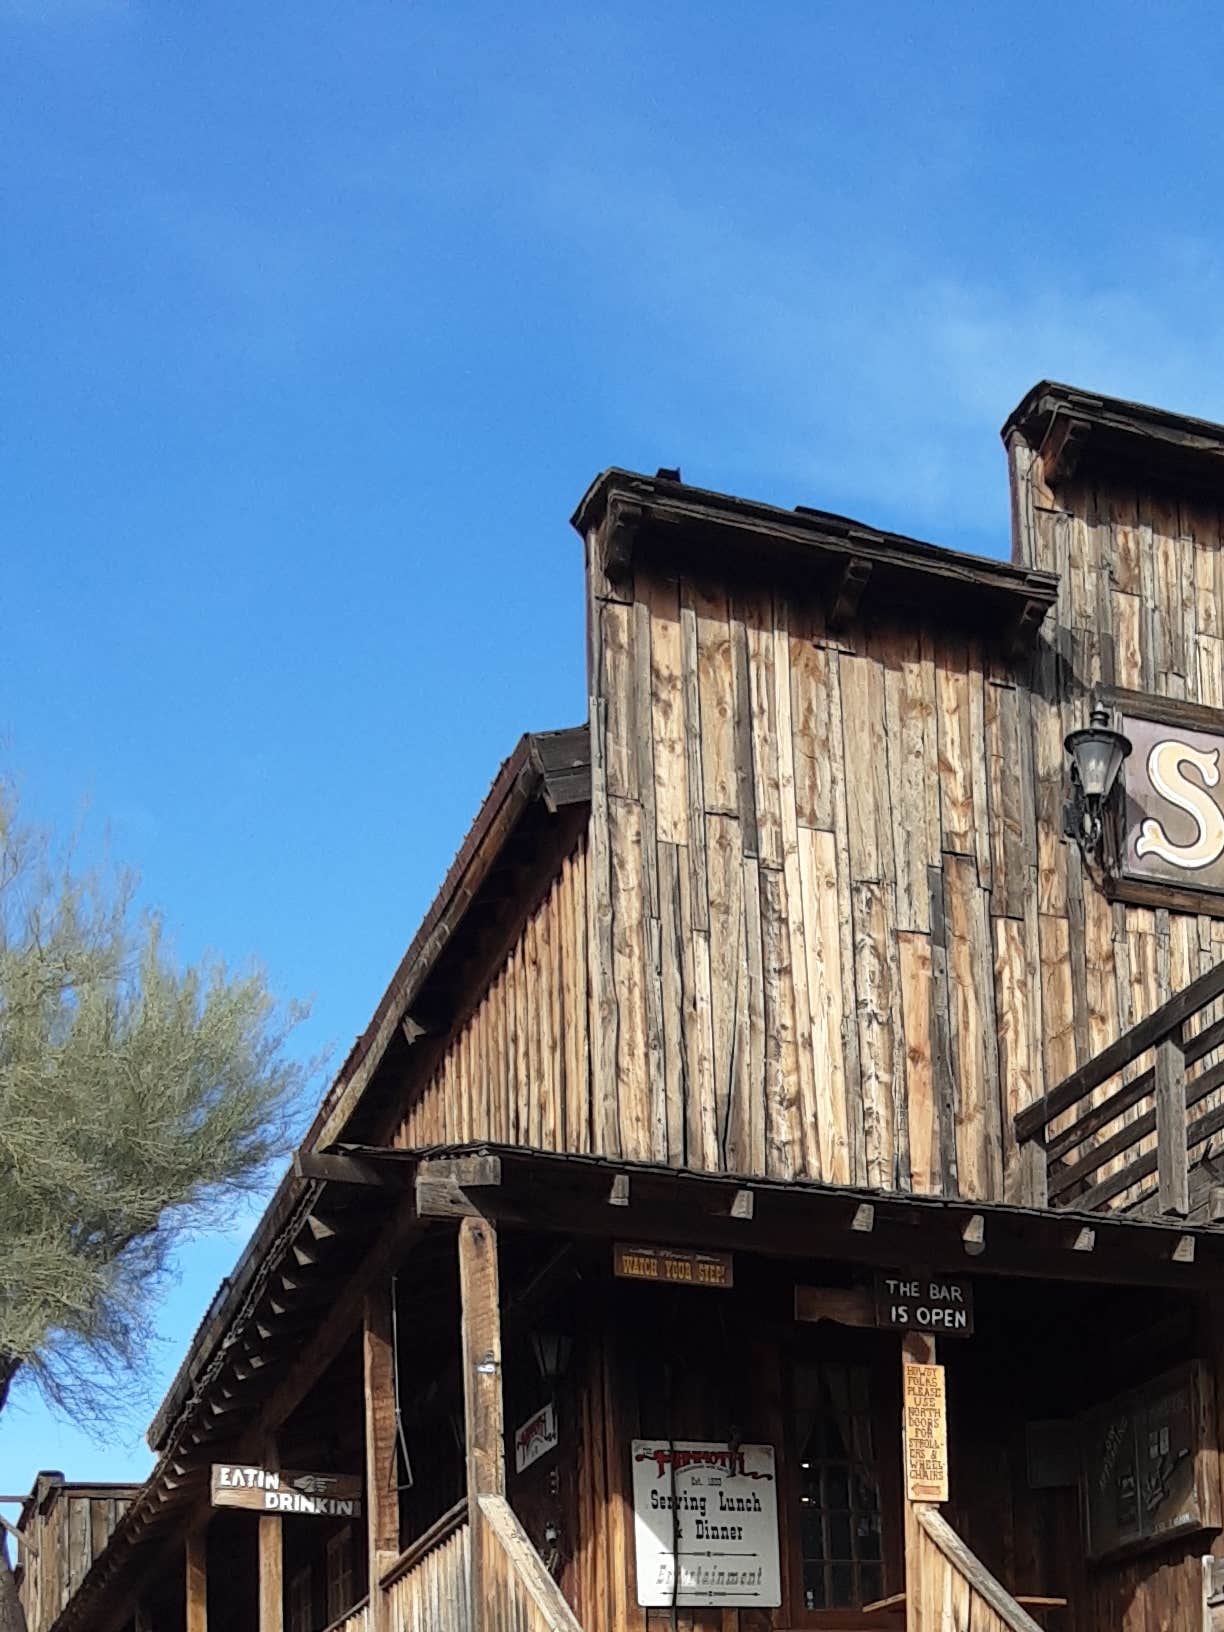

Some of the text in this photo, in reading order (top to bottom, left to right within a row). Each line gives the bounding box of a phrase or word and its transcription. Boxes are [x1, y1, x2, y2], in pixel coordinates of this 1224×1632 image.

[622, 1255, 725, 1284] WATCH YOUR STEP!
[885, 1280, 963, 1302] THE BAR
[892, 1306, 966, 1328] IS OPEN
[907, 1366, 937, 1377] HOWDY
[908, 1376, 938, 1388] FOLKS
[907, 1386, 942, 1398] PLEASE
[914, 1397, 936, 1408] USE
[908, 1407, 941, 1418] NORTH
[909, 1417, 940, 1428] DOORS
[915, 1428, 933, 1439] FOR
[220, 1467, 279, 1489] EATIN
[910, 1470, 944, 1481] CHAIRS
[264, 1491, 353, 1515] DRINKIN
[651, 1489, 762, 1516] Serving Lunch
[695, 1519, 743, 1540] Dinner
[656, 1564, 762, 1586] Enertainment
